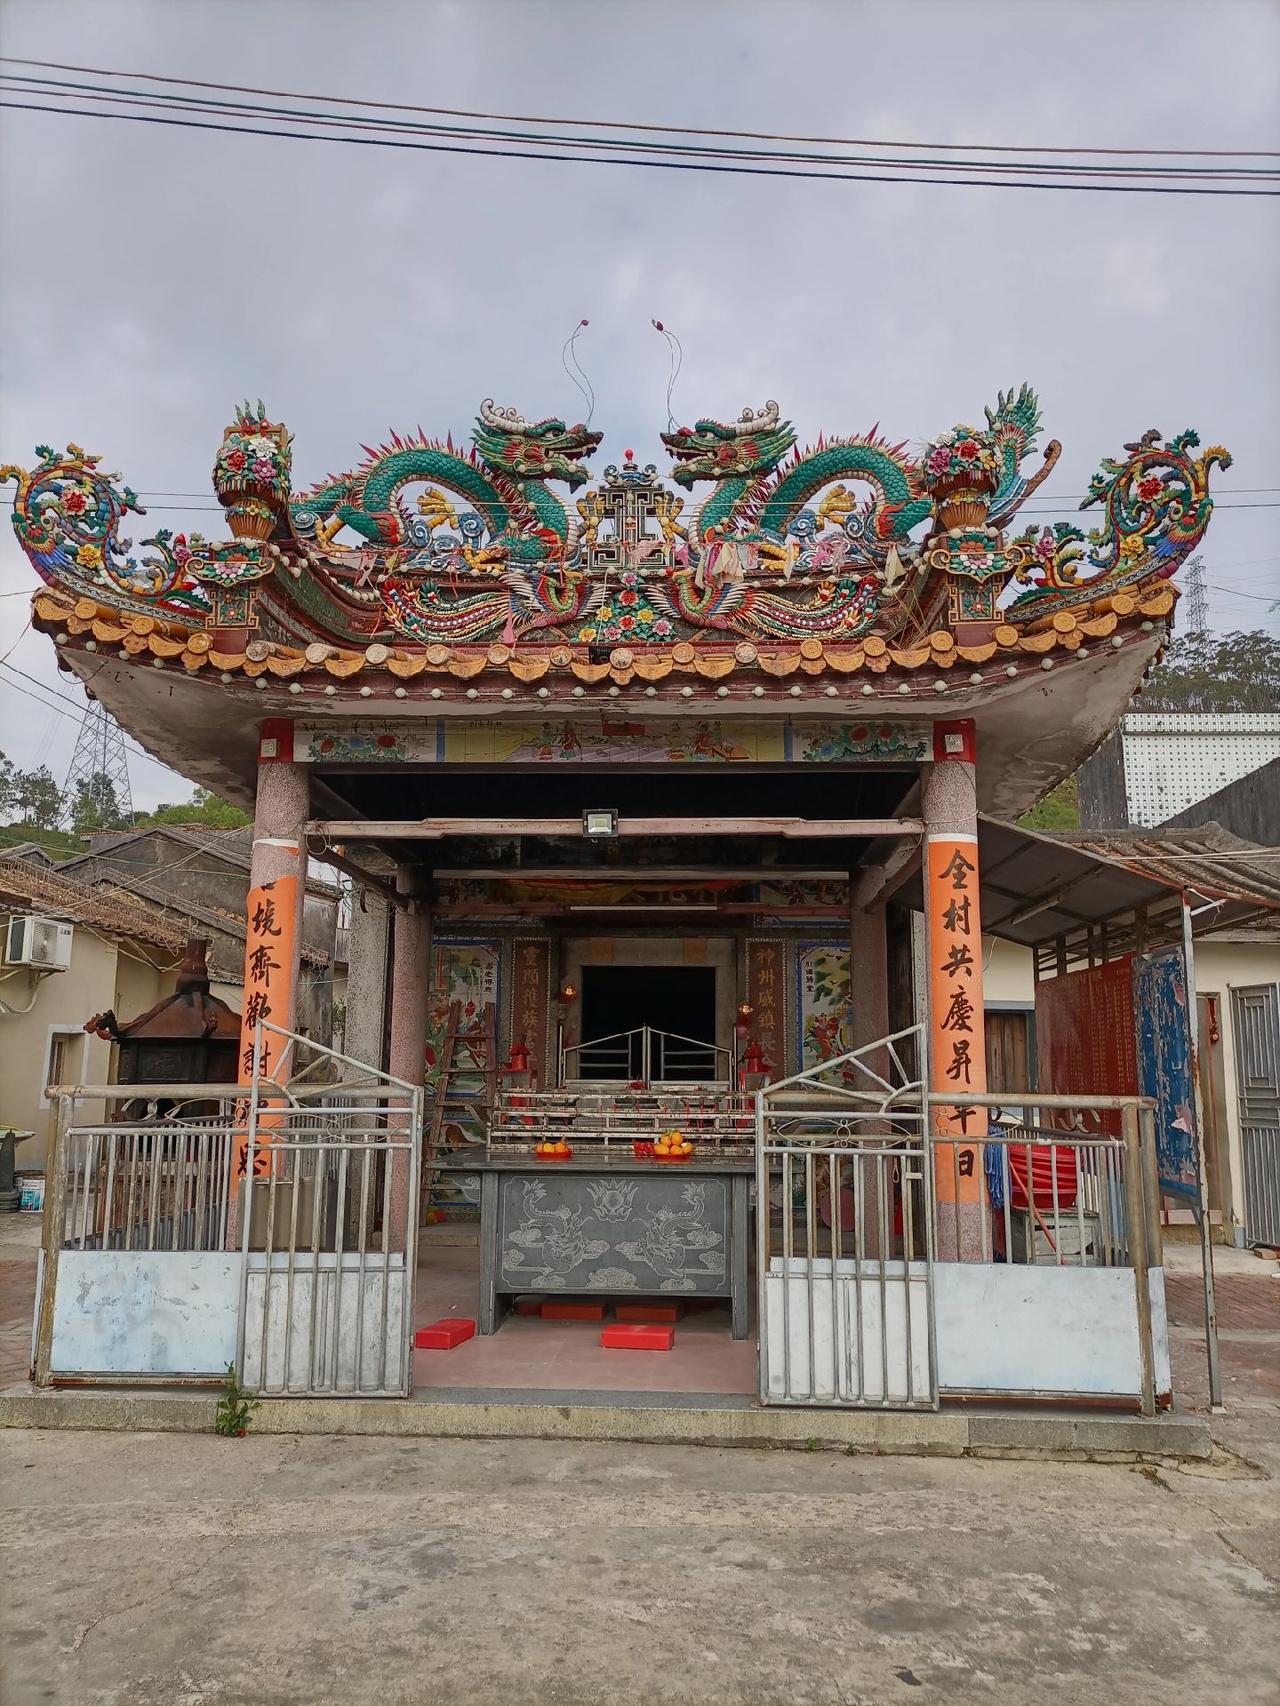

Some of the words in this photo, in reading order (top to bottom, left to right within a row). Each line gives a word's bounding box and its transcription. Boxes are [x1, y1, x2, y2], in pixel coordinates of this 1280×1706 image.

[237, 881, 282, 1176] 境齊歡謝恩
[938, 848, 976, 1178] 全村共慶昇平日
